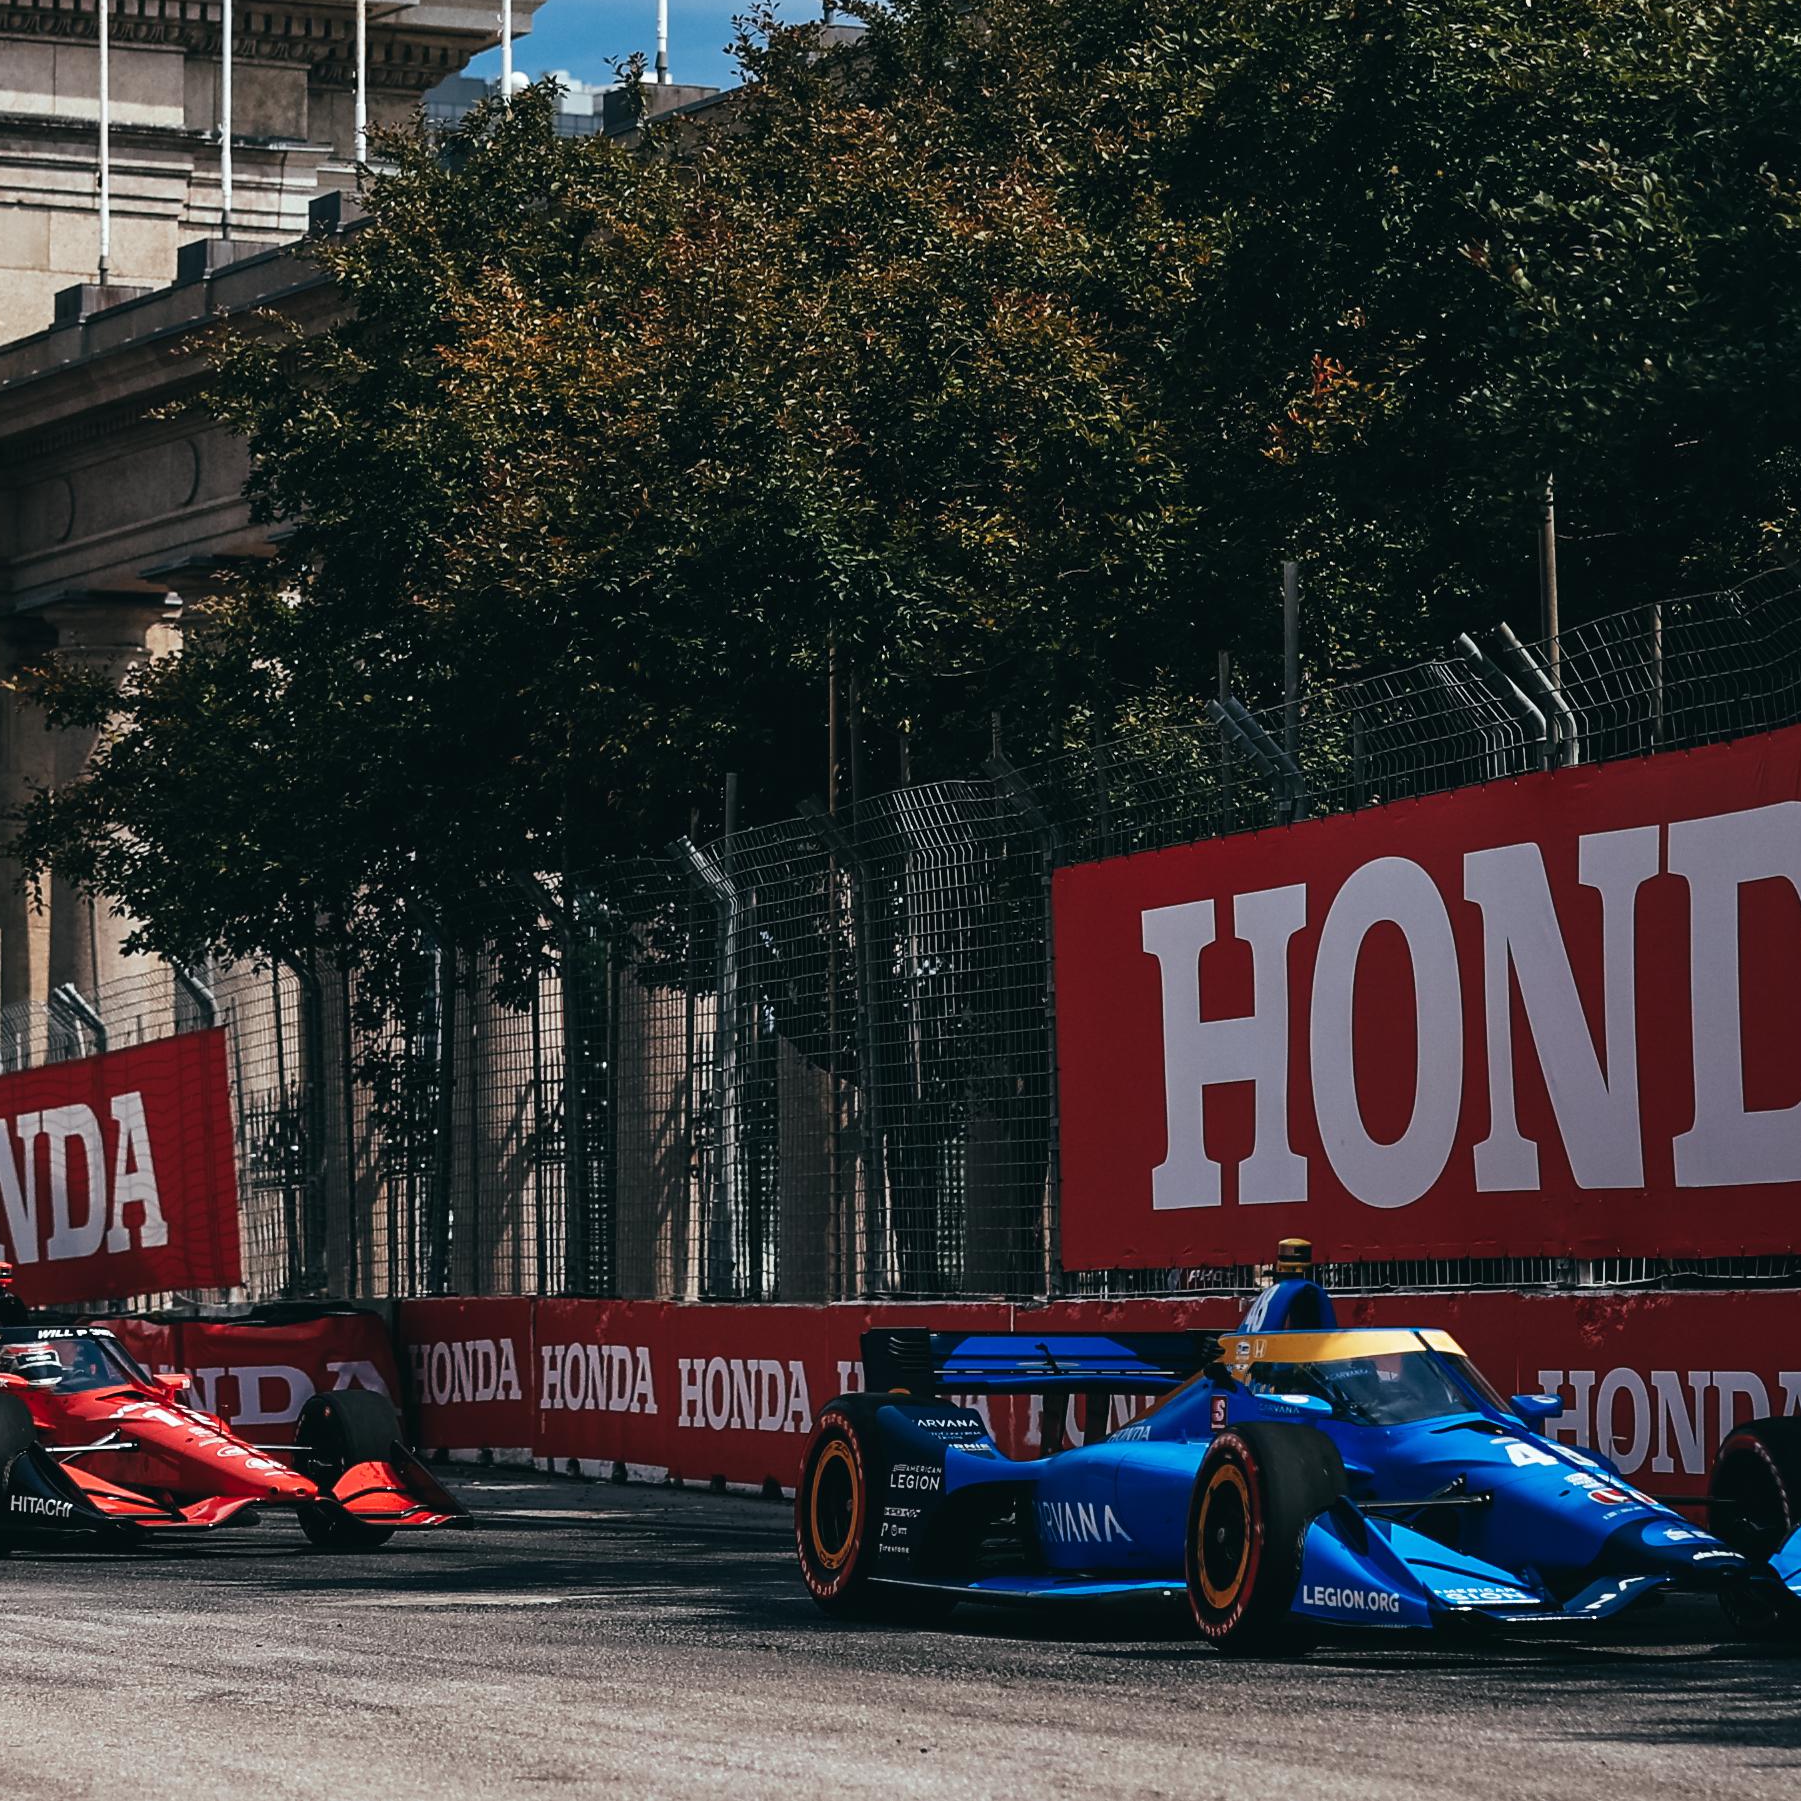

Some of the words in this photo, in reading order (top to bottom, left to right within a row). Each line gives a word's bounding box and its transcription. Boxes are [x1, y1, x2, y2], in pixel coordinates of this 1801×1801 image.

[408, 1338, 522, 1405] HONDA
[540, 1342, 658, 1414] HONDA
[678, 1357, 814, 1434] HONDA
[915, 1418, 979, 1428] ARVANA
[889, 1473, 941, 1491] LEGION
[905, 1464, 942, 1474] AMERICAN
[10, 1494, 73, 1518] HITACHI
[1303, 1584, 1401, 1614] LEGION.ORG
